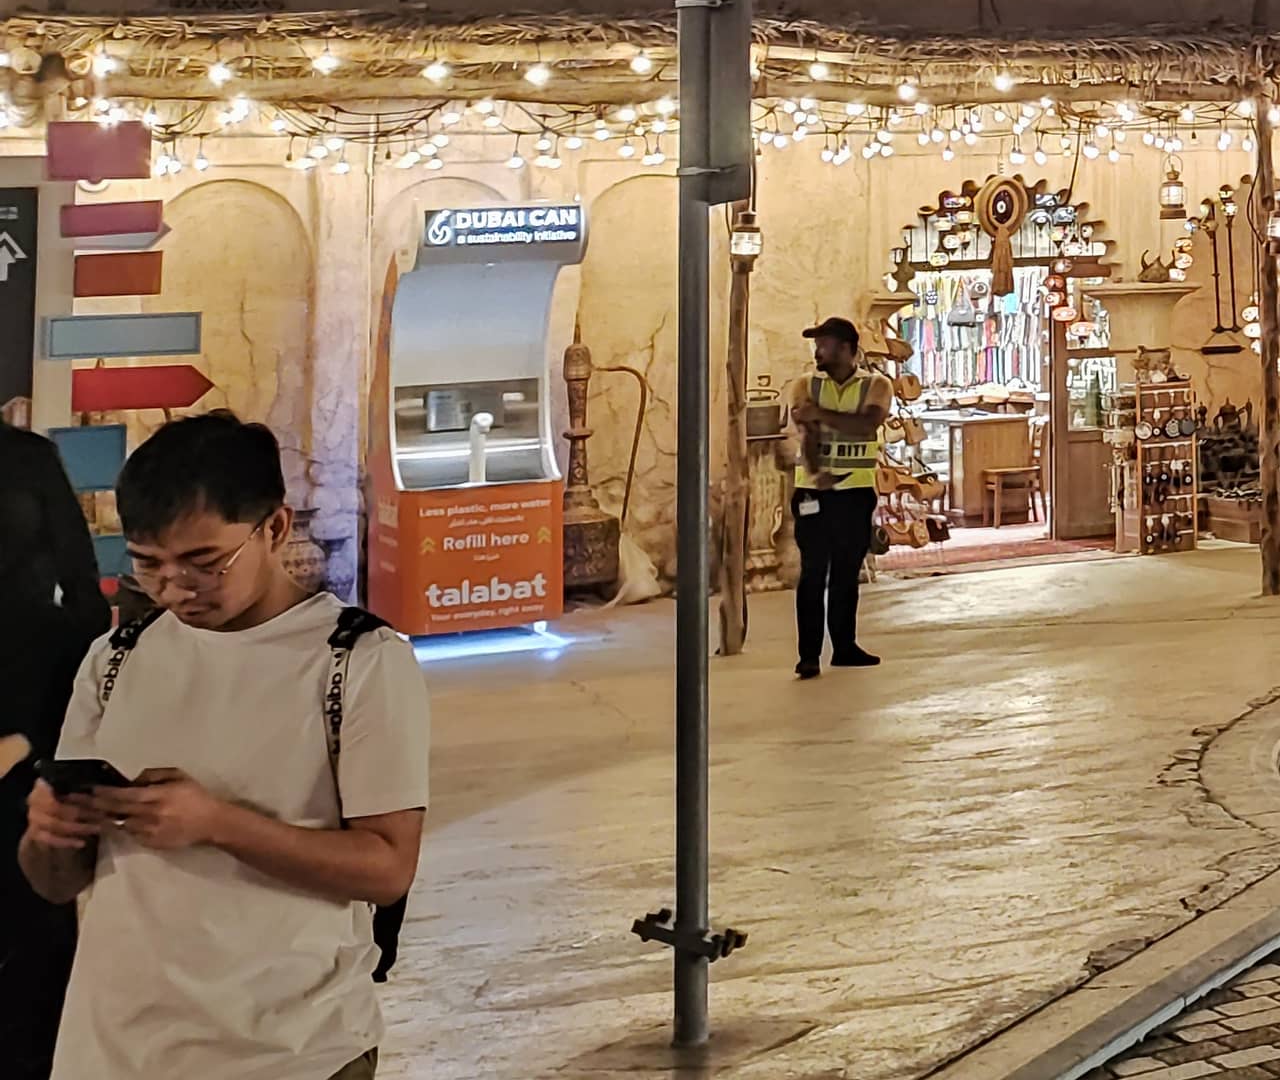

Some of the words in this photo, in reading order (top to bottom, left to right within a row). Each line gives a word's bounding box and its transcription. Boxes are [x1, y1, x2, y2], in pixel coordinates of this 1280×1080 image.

[455, 210, 525, 229] DUBAI
[529, 208, 577, 227] CAN
[443, 533, 487, 551] Refill
[490, 532, 530, 547] here
[425, 572, 547, 608] talabat
